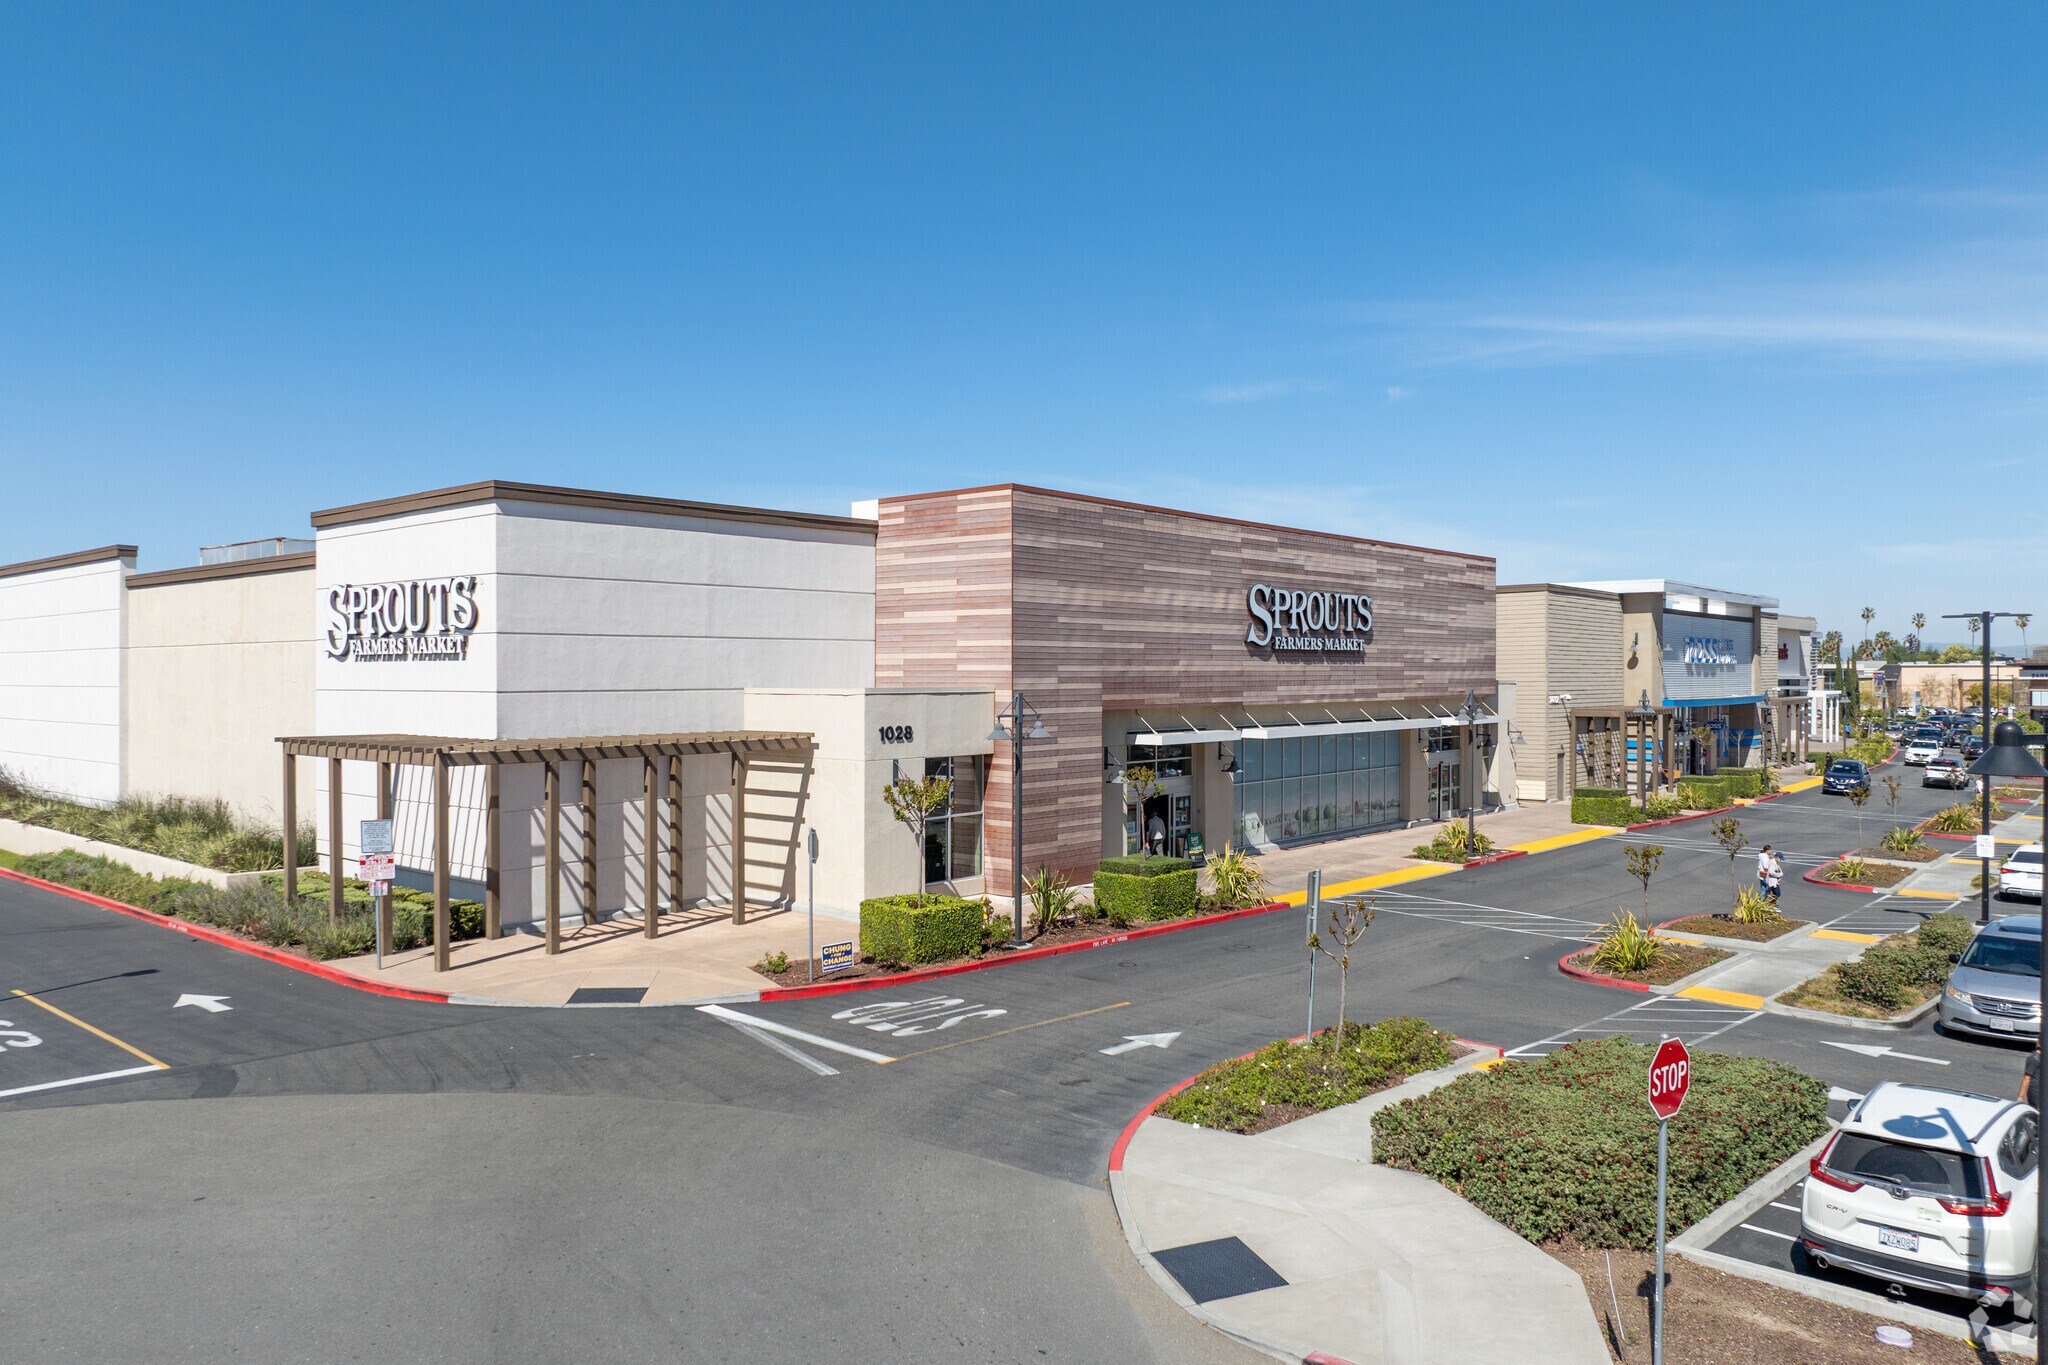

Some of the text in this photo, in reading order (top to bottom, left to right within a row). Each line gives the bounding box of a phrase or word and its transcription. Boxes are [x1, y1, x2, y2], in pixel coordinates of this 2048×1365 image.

[325, 576, 474, 657] SPROUTS
[1247, 583, 1373, 647] SPROUTS
[350, 636, 464, 656] FARMERS MARKET
[1275, 636, 1365, 651] FARMERS MARKET
[879, 725, 914, 743] 1028
[823, 943, 851, 955] CHUNG
[823, 955, 852, 966] CHANGE
[1651, 1060, 1687, 1097] STOP
[1826, 1204, 1849, 1214] CR-V
